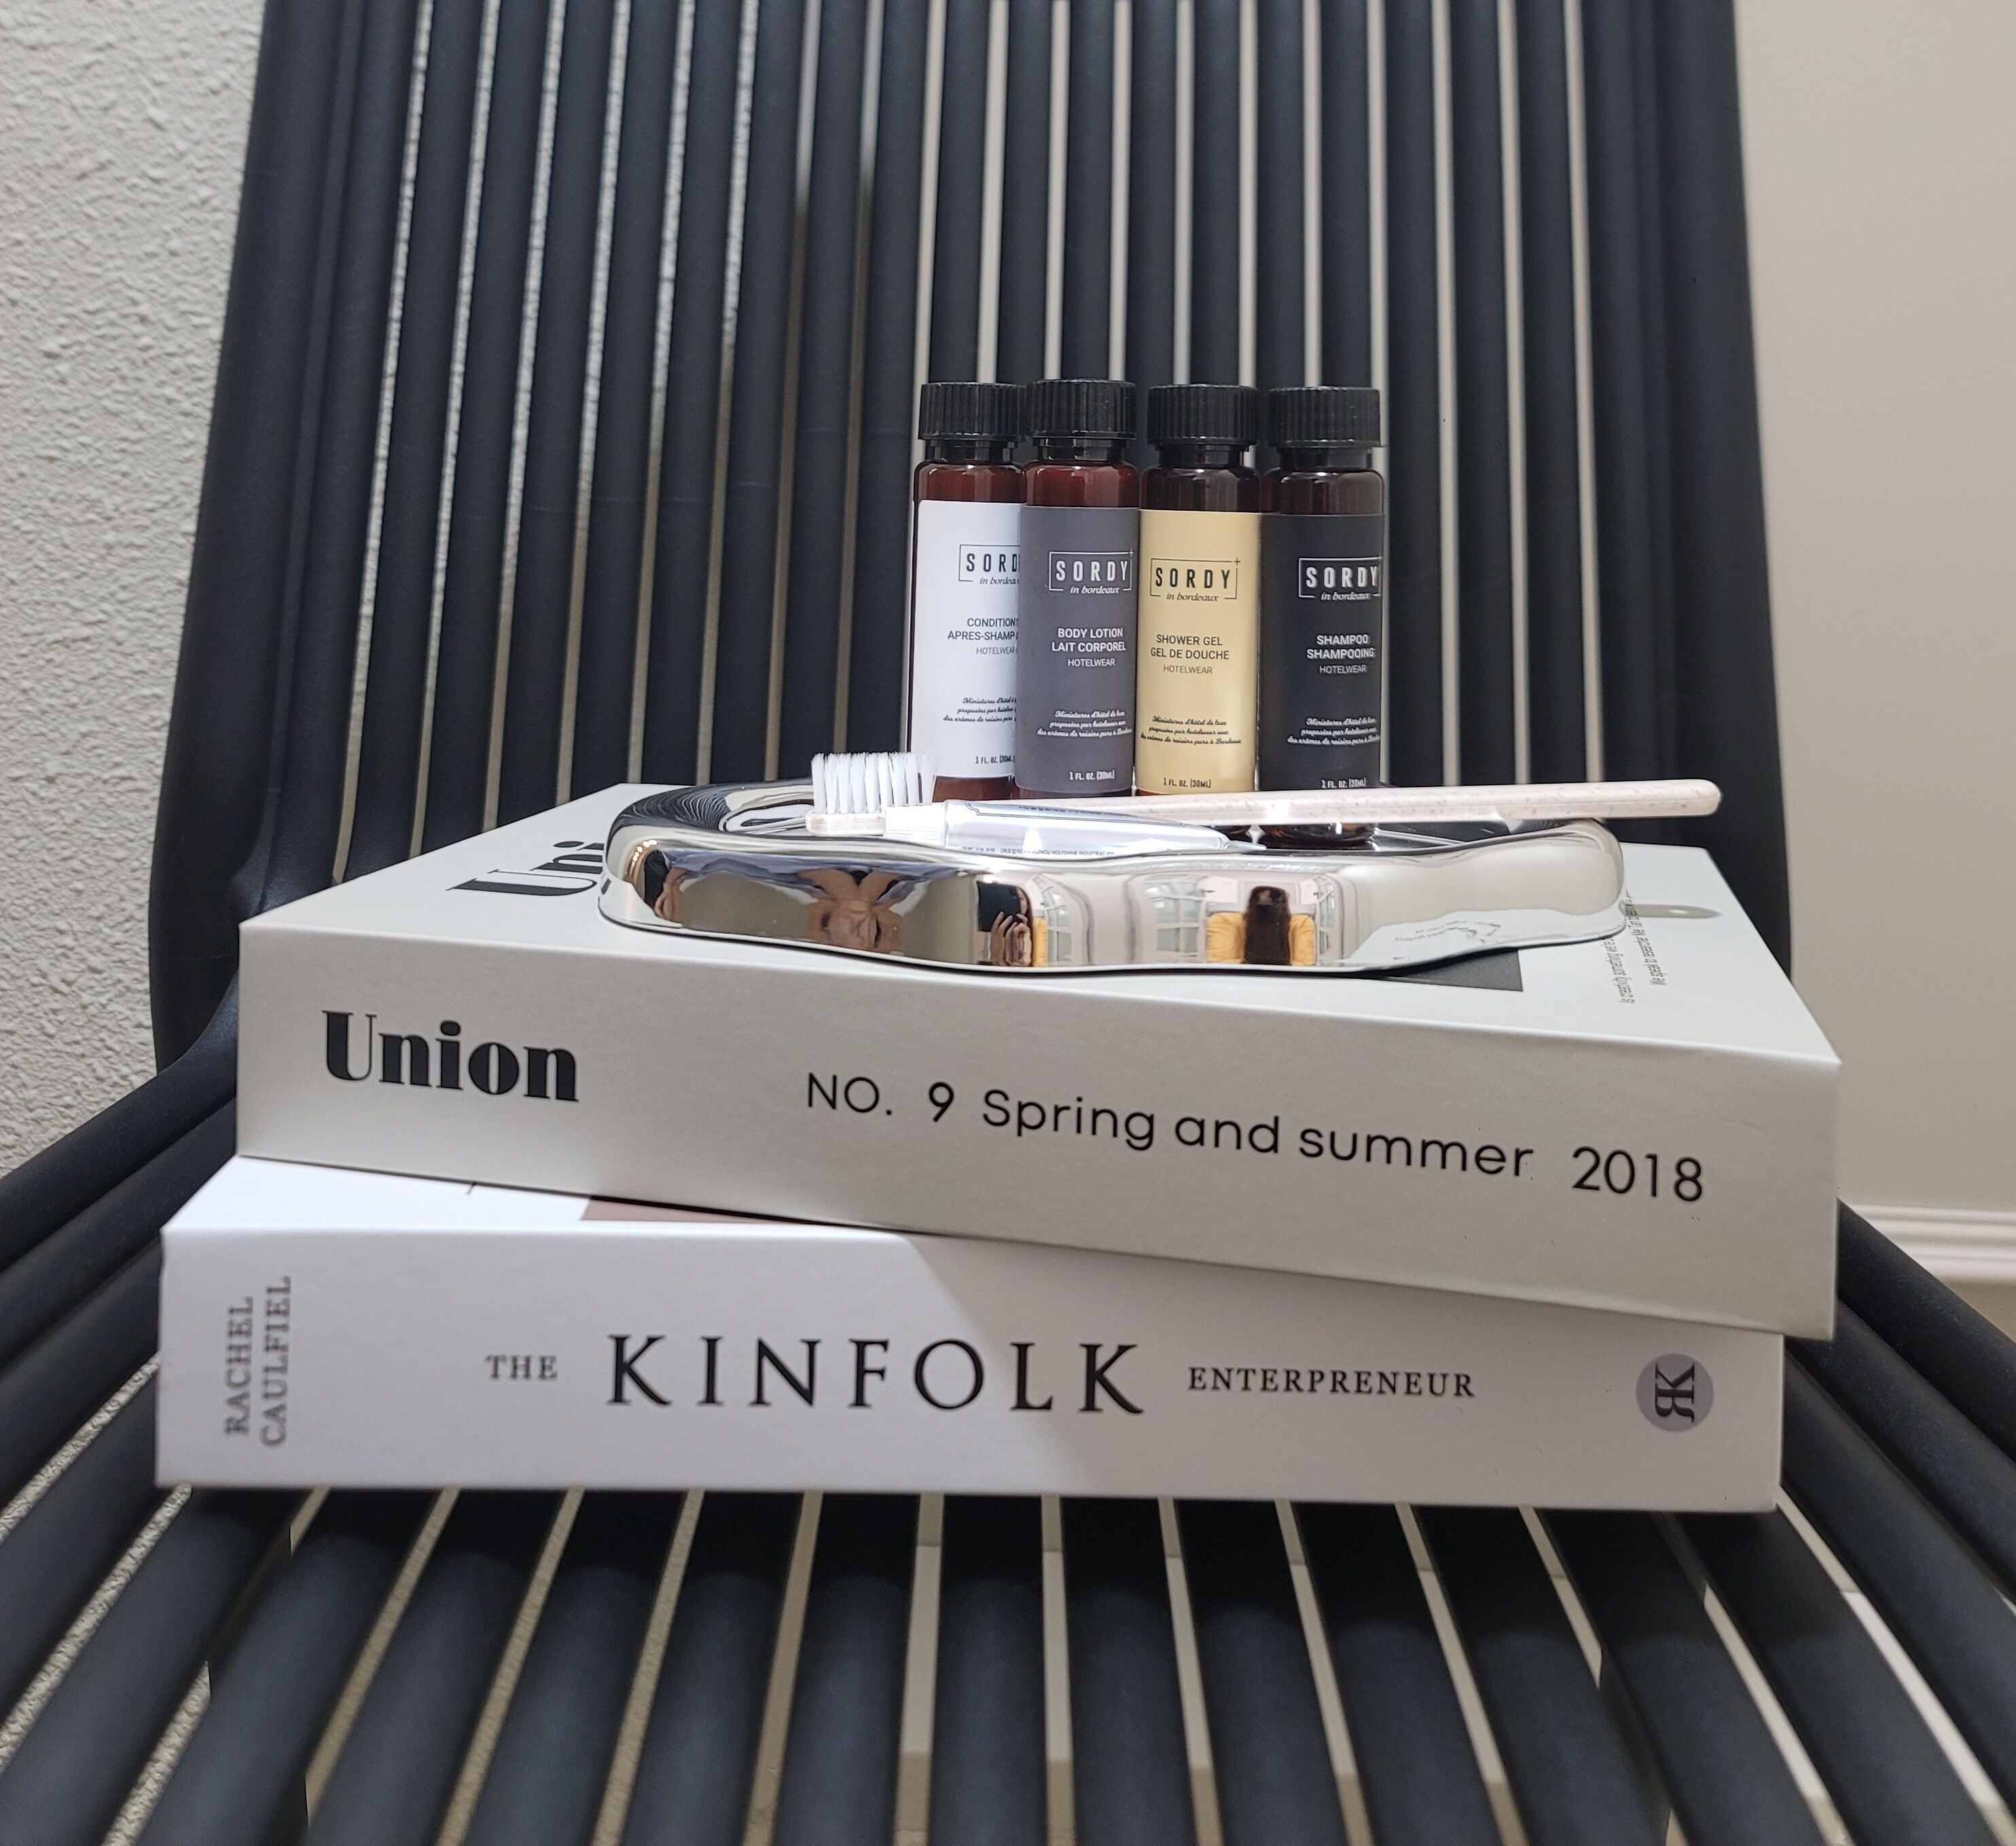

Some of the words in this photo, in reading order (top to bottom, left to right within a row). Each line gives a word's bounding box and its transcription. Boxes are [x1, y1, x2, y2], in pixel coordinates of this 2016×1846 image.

[967, 553, 1019, 572] SORD
[1056, 560, 1128, 581] SORDY
[1155, 567, 1230, 589] SORDY
[1306, 566, 1378, 588] SORDY
[1070, 585, 1079, 594] in
[1081, 585, 1119, 594] bordeaux
[1166, 592, 1174, 600] in
[1176, 593, 1219, 602] bordeaux
[1320, 592, 1331, 600] in
[1332, 592, 1370, 600] bordeaux
[967, 617, 1018, 627] CONDITION
[948, 630, 1018, 640] APRES-SHAMP
[1058, 628, 1087, 638] BODY
[1090, 628, 1123, 638] LOTION
[1156, 634, 1200, 645] SHOWER
[1203, 636, 1223, 646] GEL
[1316, 634, 1369, 645] SHAMPOO
[1051, 642, 1076, 652] LAIT
[1077, 641, 1126, 652] CORPOREL
[1151, 647, 1167, 657] GEL
[1170, 649, 1183, 658] DE
[1185, 650, 1229, 659] DOUCHE
[1306, 648, 1375, 659] SHAMPOOING
[1068, 658, 1115, 667] HOTELWEAR
[1164, 664, 1212, 674] HOTELWEAR
[1319, 665, 1367, 674] HOTELWEAR
[1152, 715, 1184, 725] Miniatures
[1306, 717, 1342, 725] Miniatures
[1287, 735, 1297, 743] des
[1069, 772, 1073, 780] 1
[1163, 778, 1167, 786] 1
[1321, 779, 1326, 788] 1
[445, 840, 604, 897] Uni
[321, 1009, 579, 1102] Union
[806, 1072, 893, 1117] NO.
[927, 1081, 955, 1123] 9
[982, 1088, 1156, 1151] Spring
[1174, 1115, 1280, 1155] and
[1298, 1124, 1534, 1178] summer
[1571, 1145, 1704, 1202] 2018
[223, 1296, 254, 1437] RACHEL
[259, 1275, 291, 1448] CAULFIEL
[484, 1354, 559, 1381] THE
[607, 1332, 1144, 1416] KINFOLK
[1188, 1367, 1475, 1398] ENTERPRENEUR
